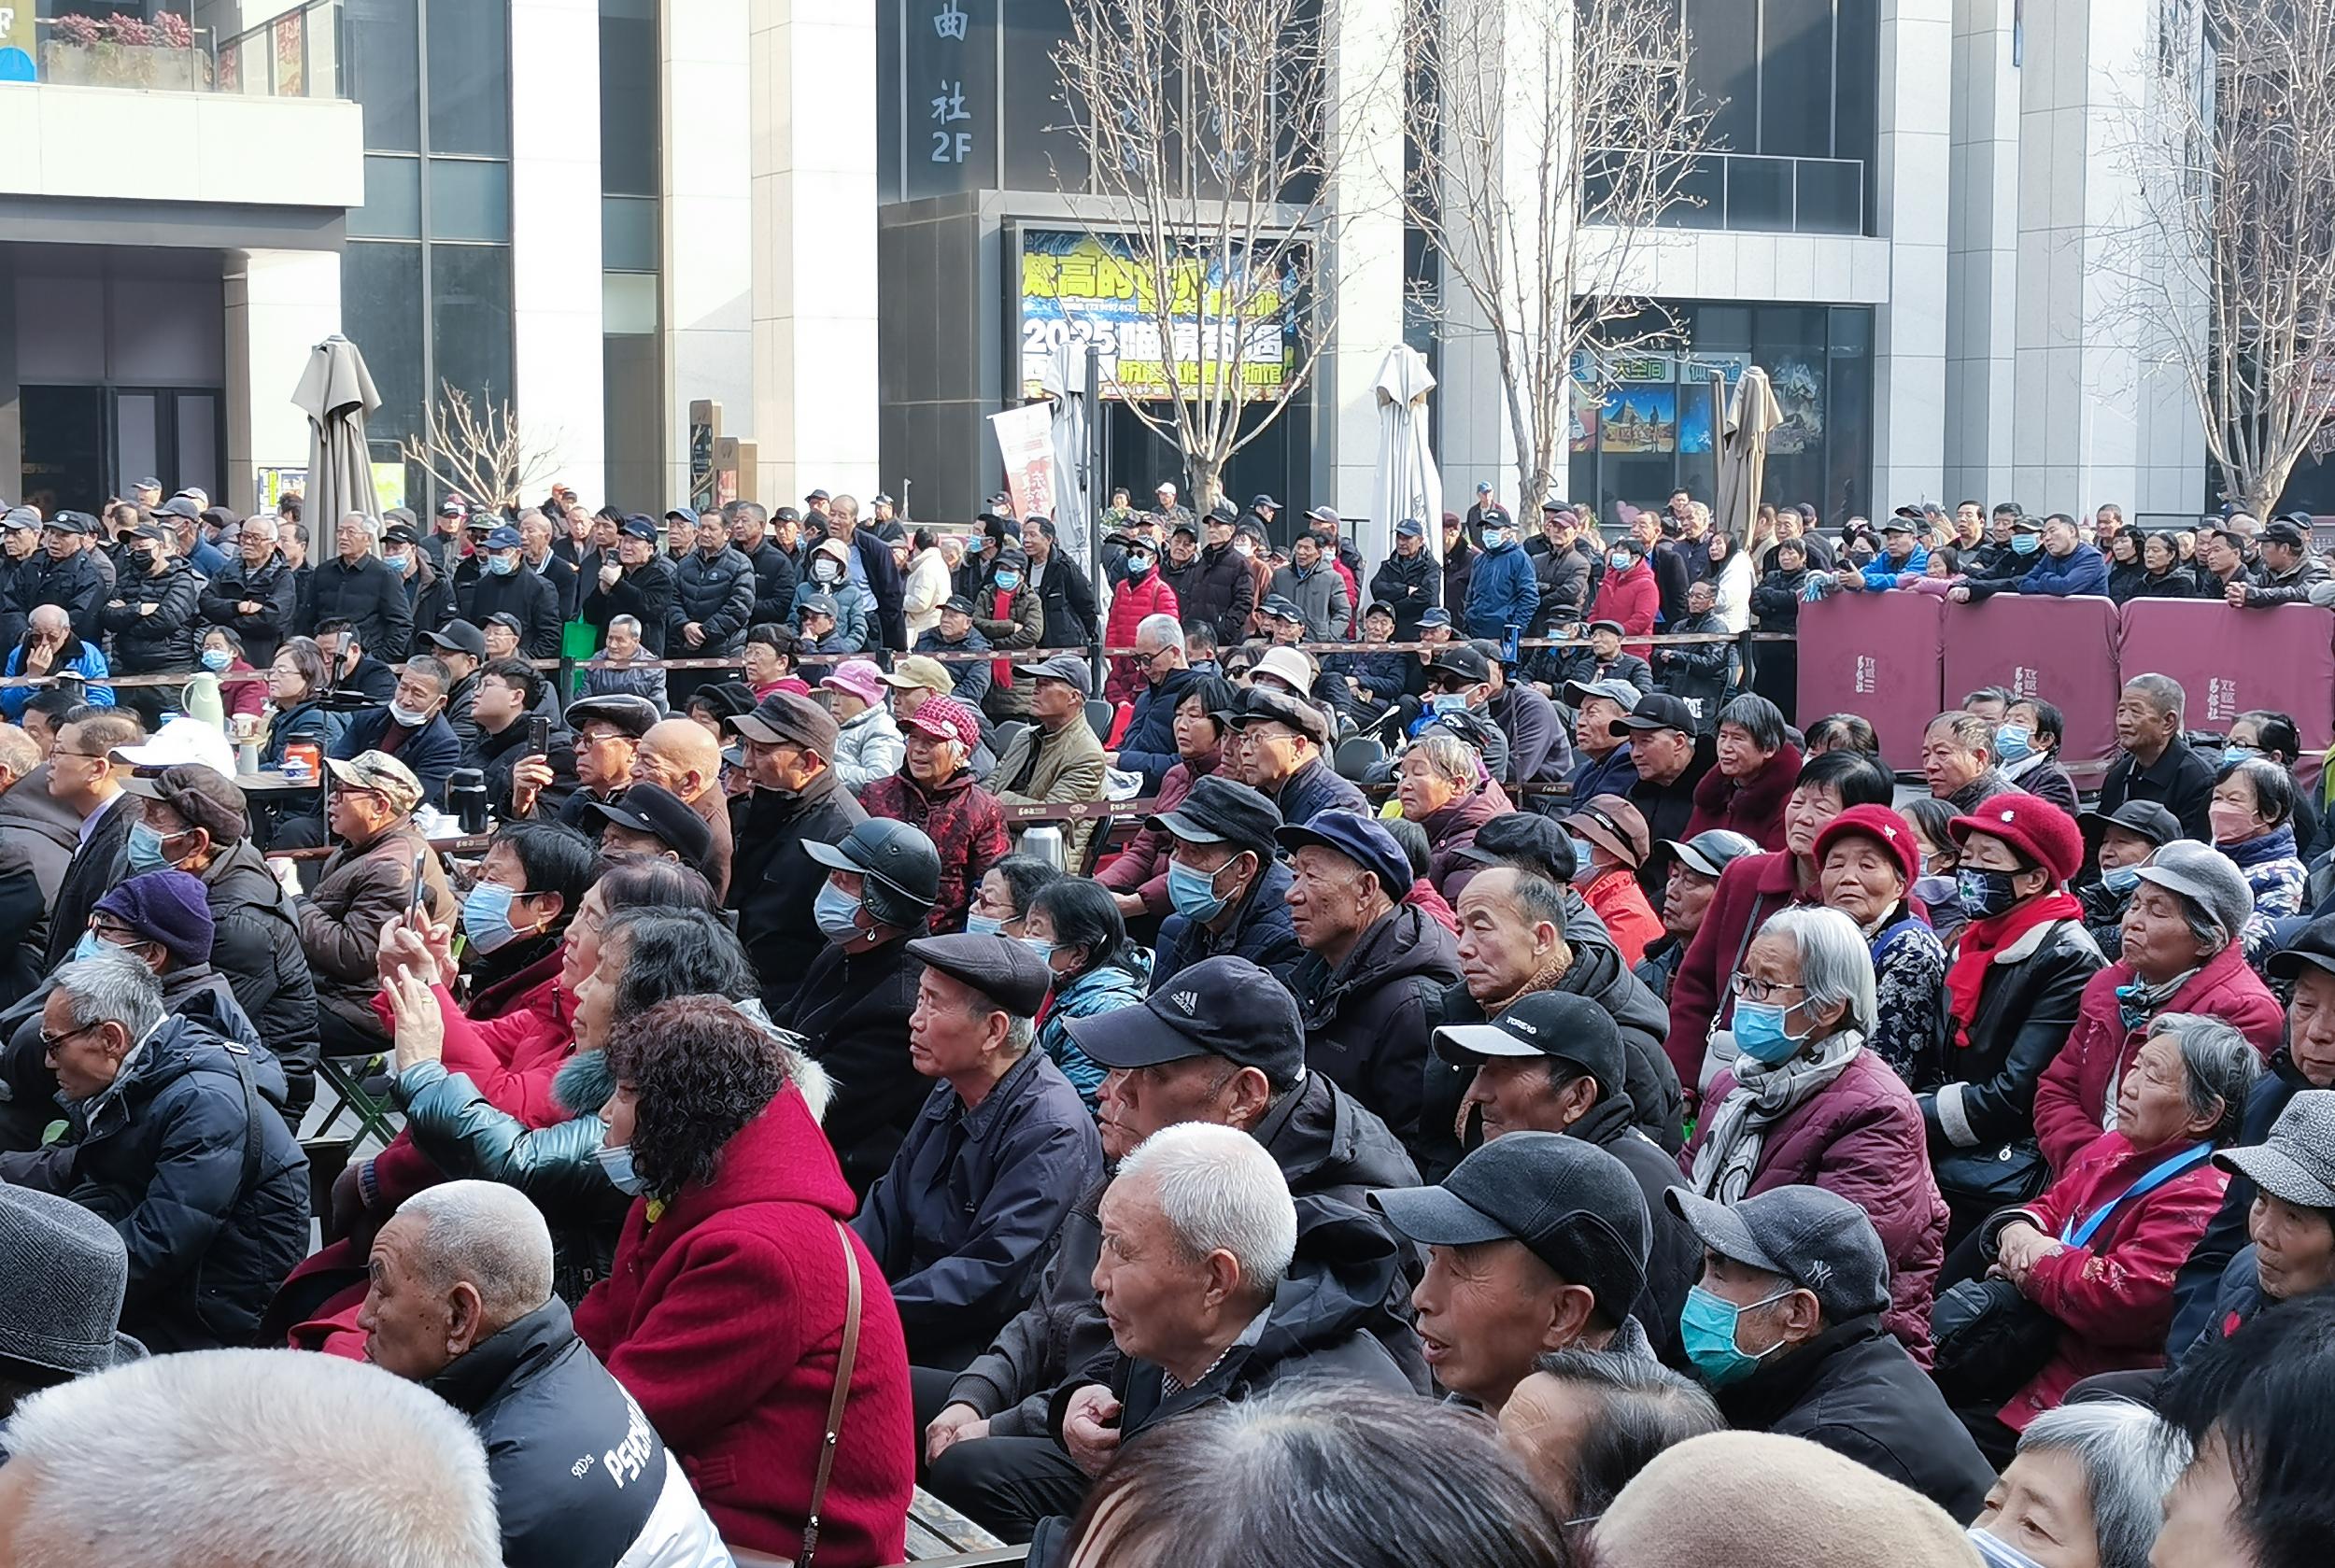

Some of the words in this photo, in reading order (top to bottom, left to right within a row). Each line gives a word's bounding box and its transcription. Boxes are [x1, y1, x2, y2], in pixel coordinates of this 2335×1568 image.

[931, 131, 972, 162] 2F
[1614, 360, 1664, 380] 大空间
[1690, 360, 1740, 381] 体馆
[1804, 1260, 1833, 1290] NY
